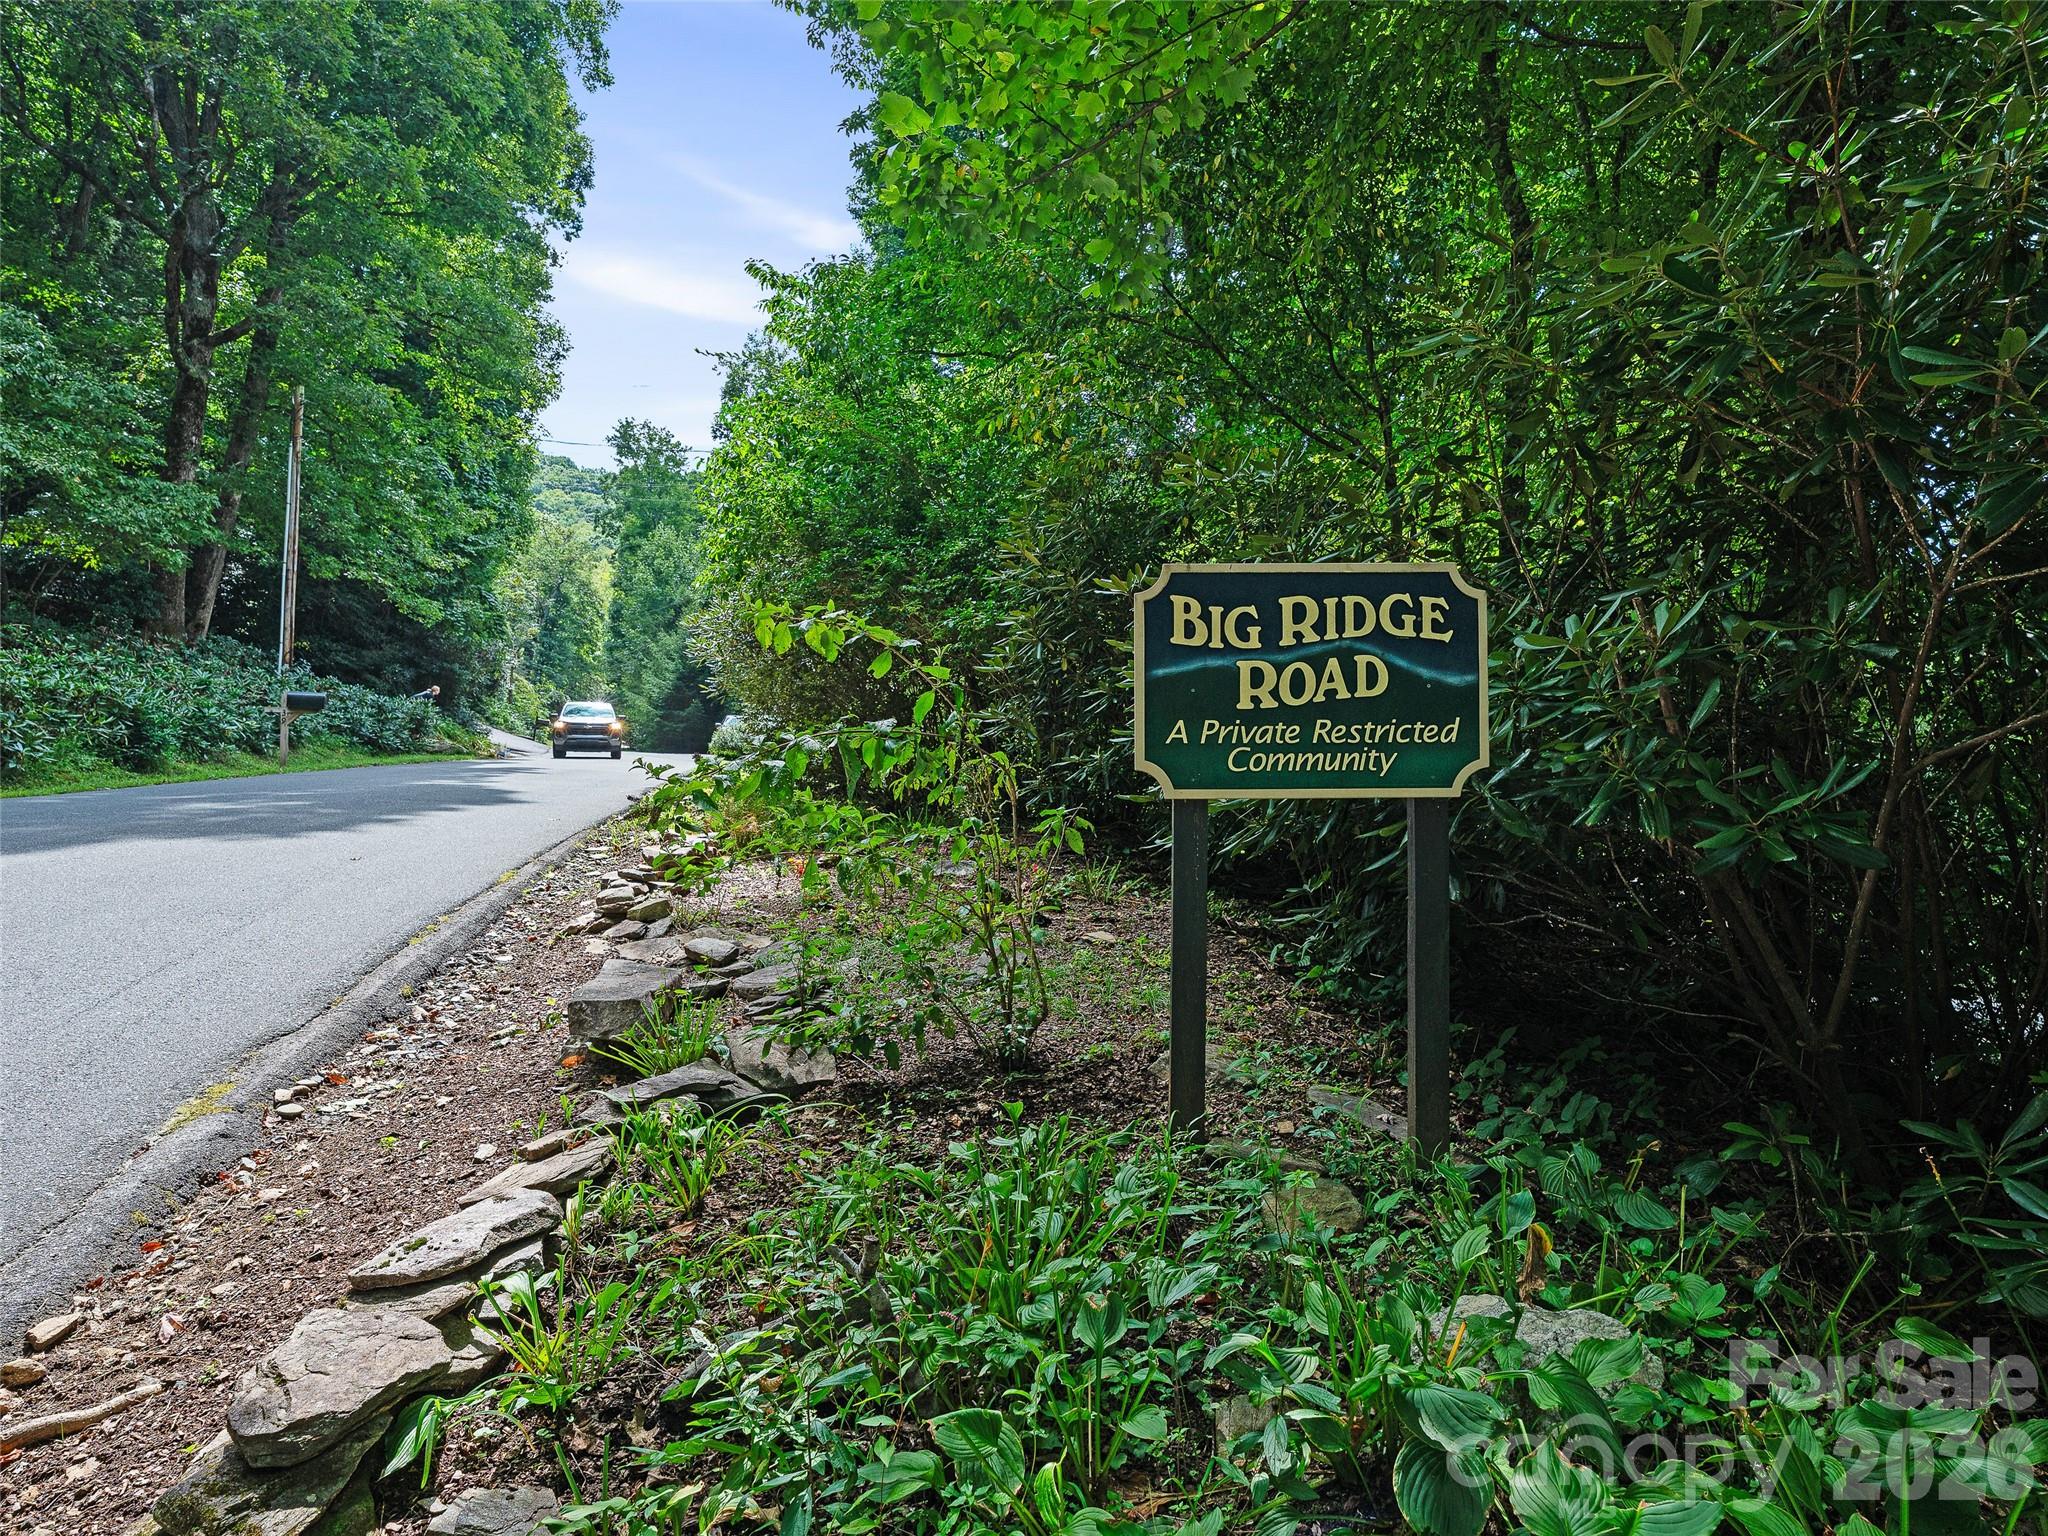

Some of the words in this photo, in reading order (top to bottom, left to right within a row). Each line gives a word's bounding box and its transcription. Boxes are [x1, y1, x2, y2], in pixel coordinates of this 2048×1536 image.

[1169, 594, 1262, 649] BIG
[1278, 592, 1454, 647] RIDGE
[1235, 654, 1389, 710] ROAD
[1165, 719, 1189, 744] A
[1200, 719, 1301, 744] Private
[1312, 717, 1460, 744] Restricted
[1227, 747, 1398, 777] Community
